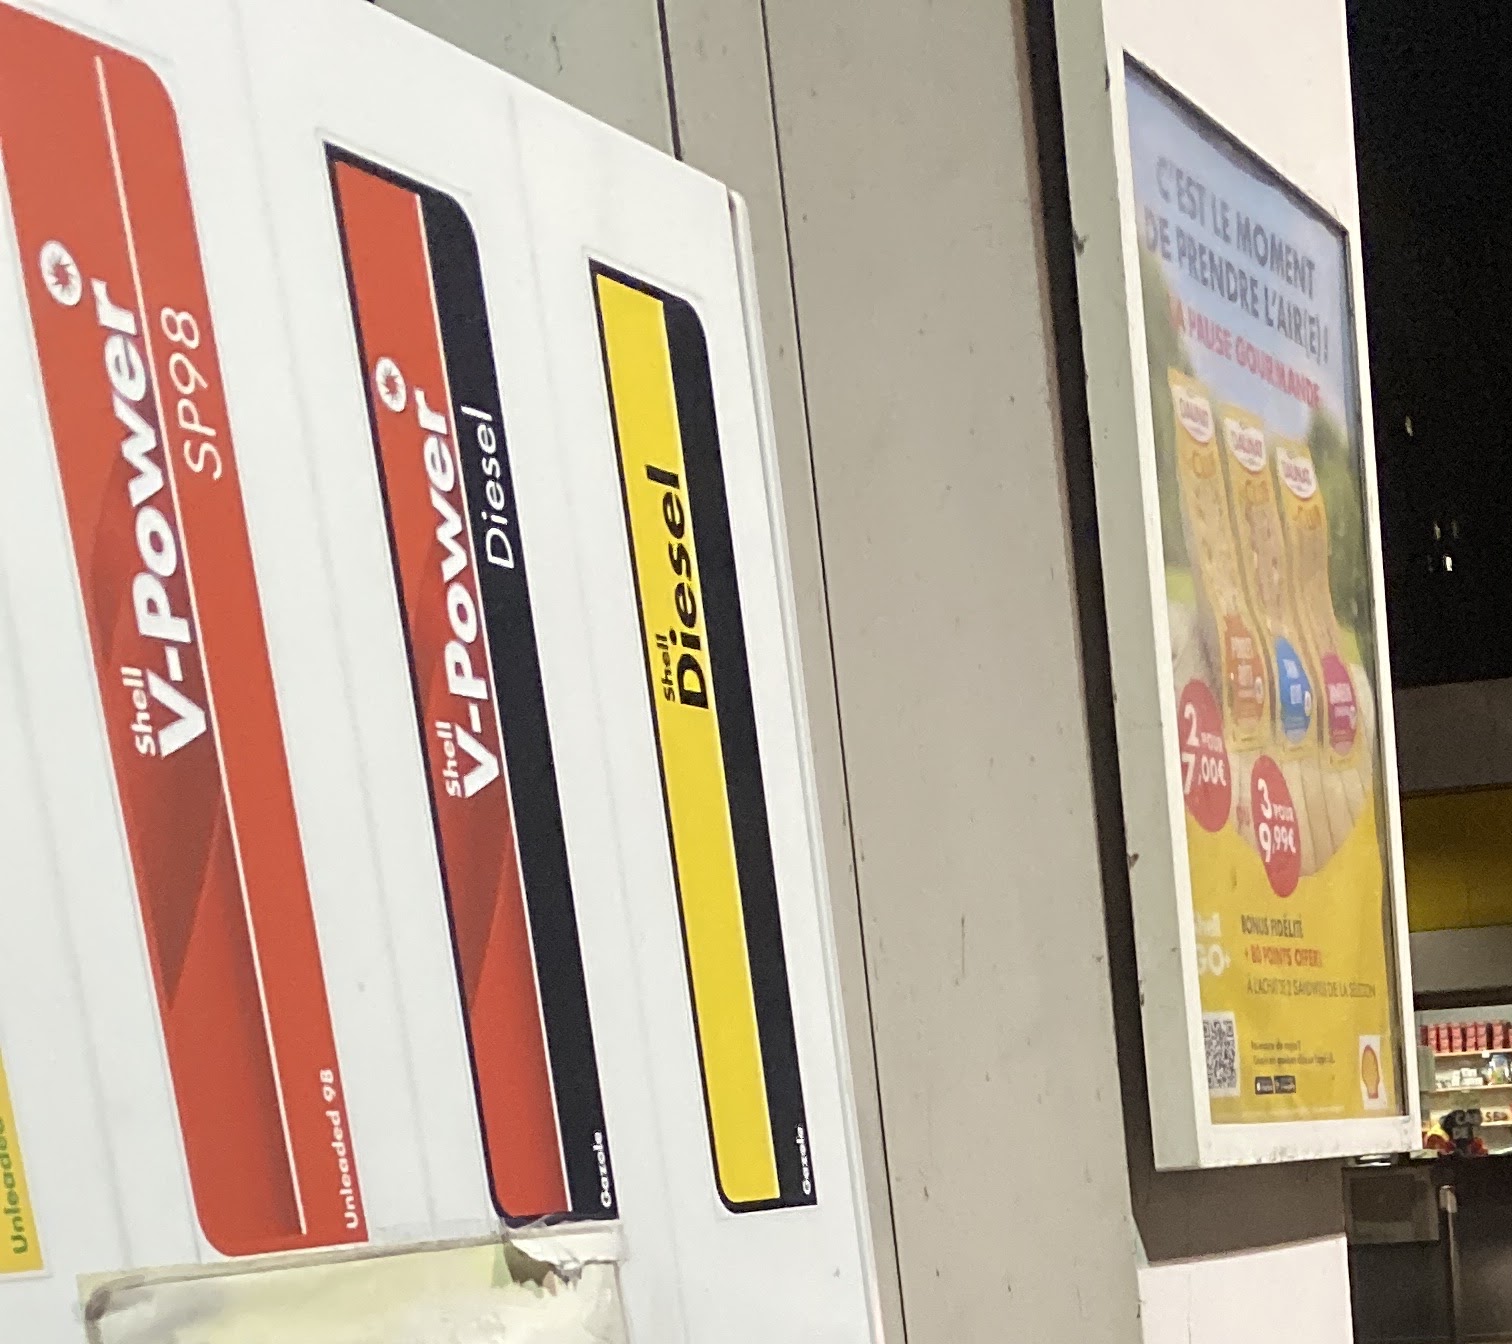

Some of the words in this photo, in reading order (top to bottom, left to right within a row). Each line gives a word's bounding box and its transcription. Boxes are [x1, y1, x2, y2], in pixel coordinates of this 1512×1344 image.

[1144, 205, 1172, 262] DE
[1176, 226, 1259, 319] PRENDRE
[1157, 157, 1206, 227] C'EST
[1211, 192, 1231, 243] LE
[1236, 211, 1315, 300] MOMENT
[160, 306, 222, 480] SP98
[91, 278, 208, 758] V-Power
[461, 405, 516, 570] Diesel
[413, 387, 500, 800] V-Power
[646, 465, 710, 711] Diesel
[121, 666, 159, 758] Shell
[646, 633, 676, 703] Shell
[1184, 702, 1200, 747] 2
[438, 721, 463, 798] Shell
[1257, 778, 1273, 820] 3
[319, 1069, 338, 1103] 98
[325, 1110, 358, 1229] Unleaded
